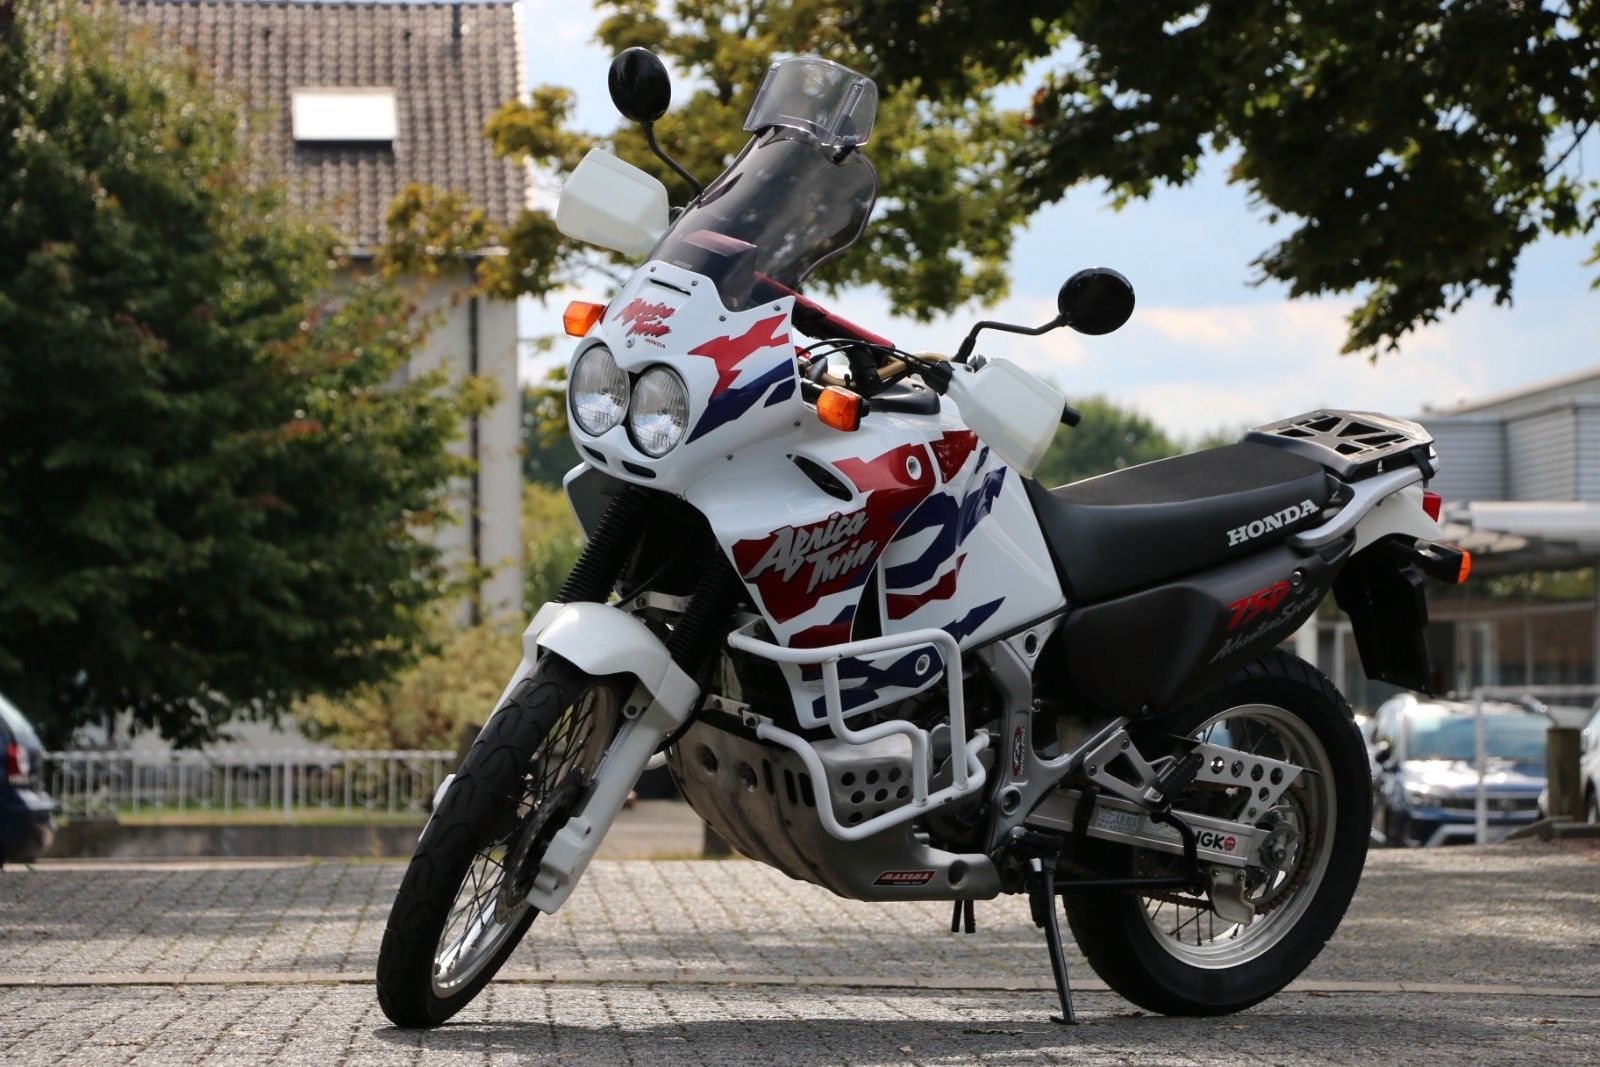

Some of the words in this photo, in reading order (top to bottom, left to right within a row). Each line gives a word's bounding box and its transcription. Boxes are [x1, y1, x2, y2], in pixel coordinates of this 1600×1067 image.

[743, 510, 869, 583] Africa
[1226, 499, 1319, 547] HONDA
[805, 540, 879, 595] Twin
